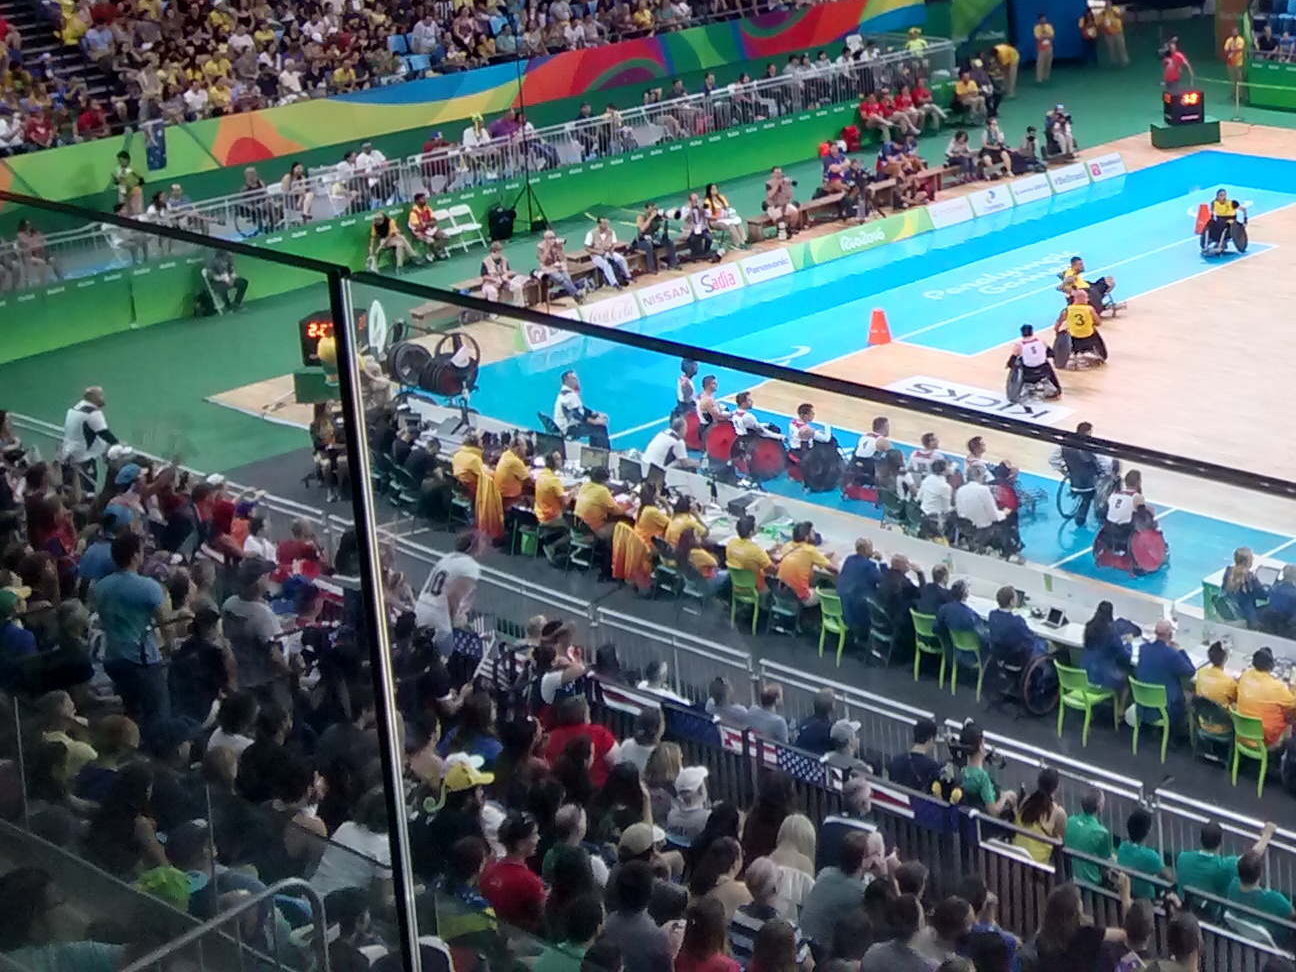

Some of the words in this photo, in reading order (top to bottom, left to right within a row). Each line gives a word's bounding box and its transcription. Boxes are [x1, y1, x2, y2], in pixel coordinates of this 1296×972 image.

[841, 227, 886, 251] Rio2016
[745, 256, 789, 276] Panasonic
[700, 271, 736, 294] Sadia
[642, 285, 690, 308] NISSAN
[1074, 314, 1086, 327] 3
[905, 382, 1051, 420] KICKS
[1114, 498, 1123, 509] 2
